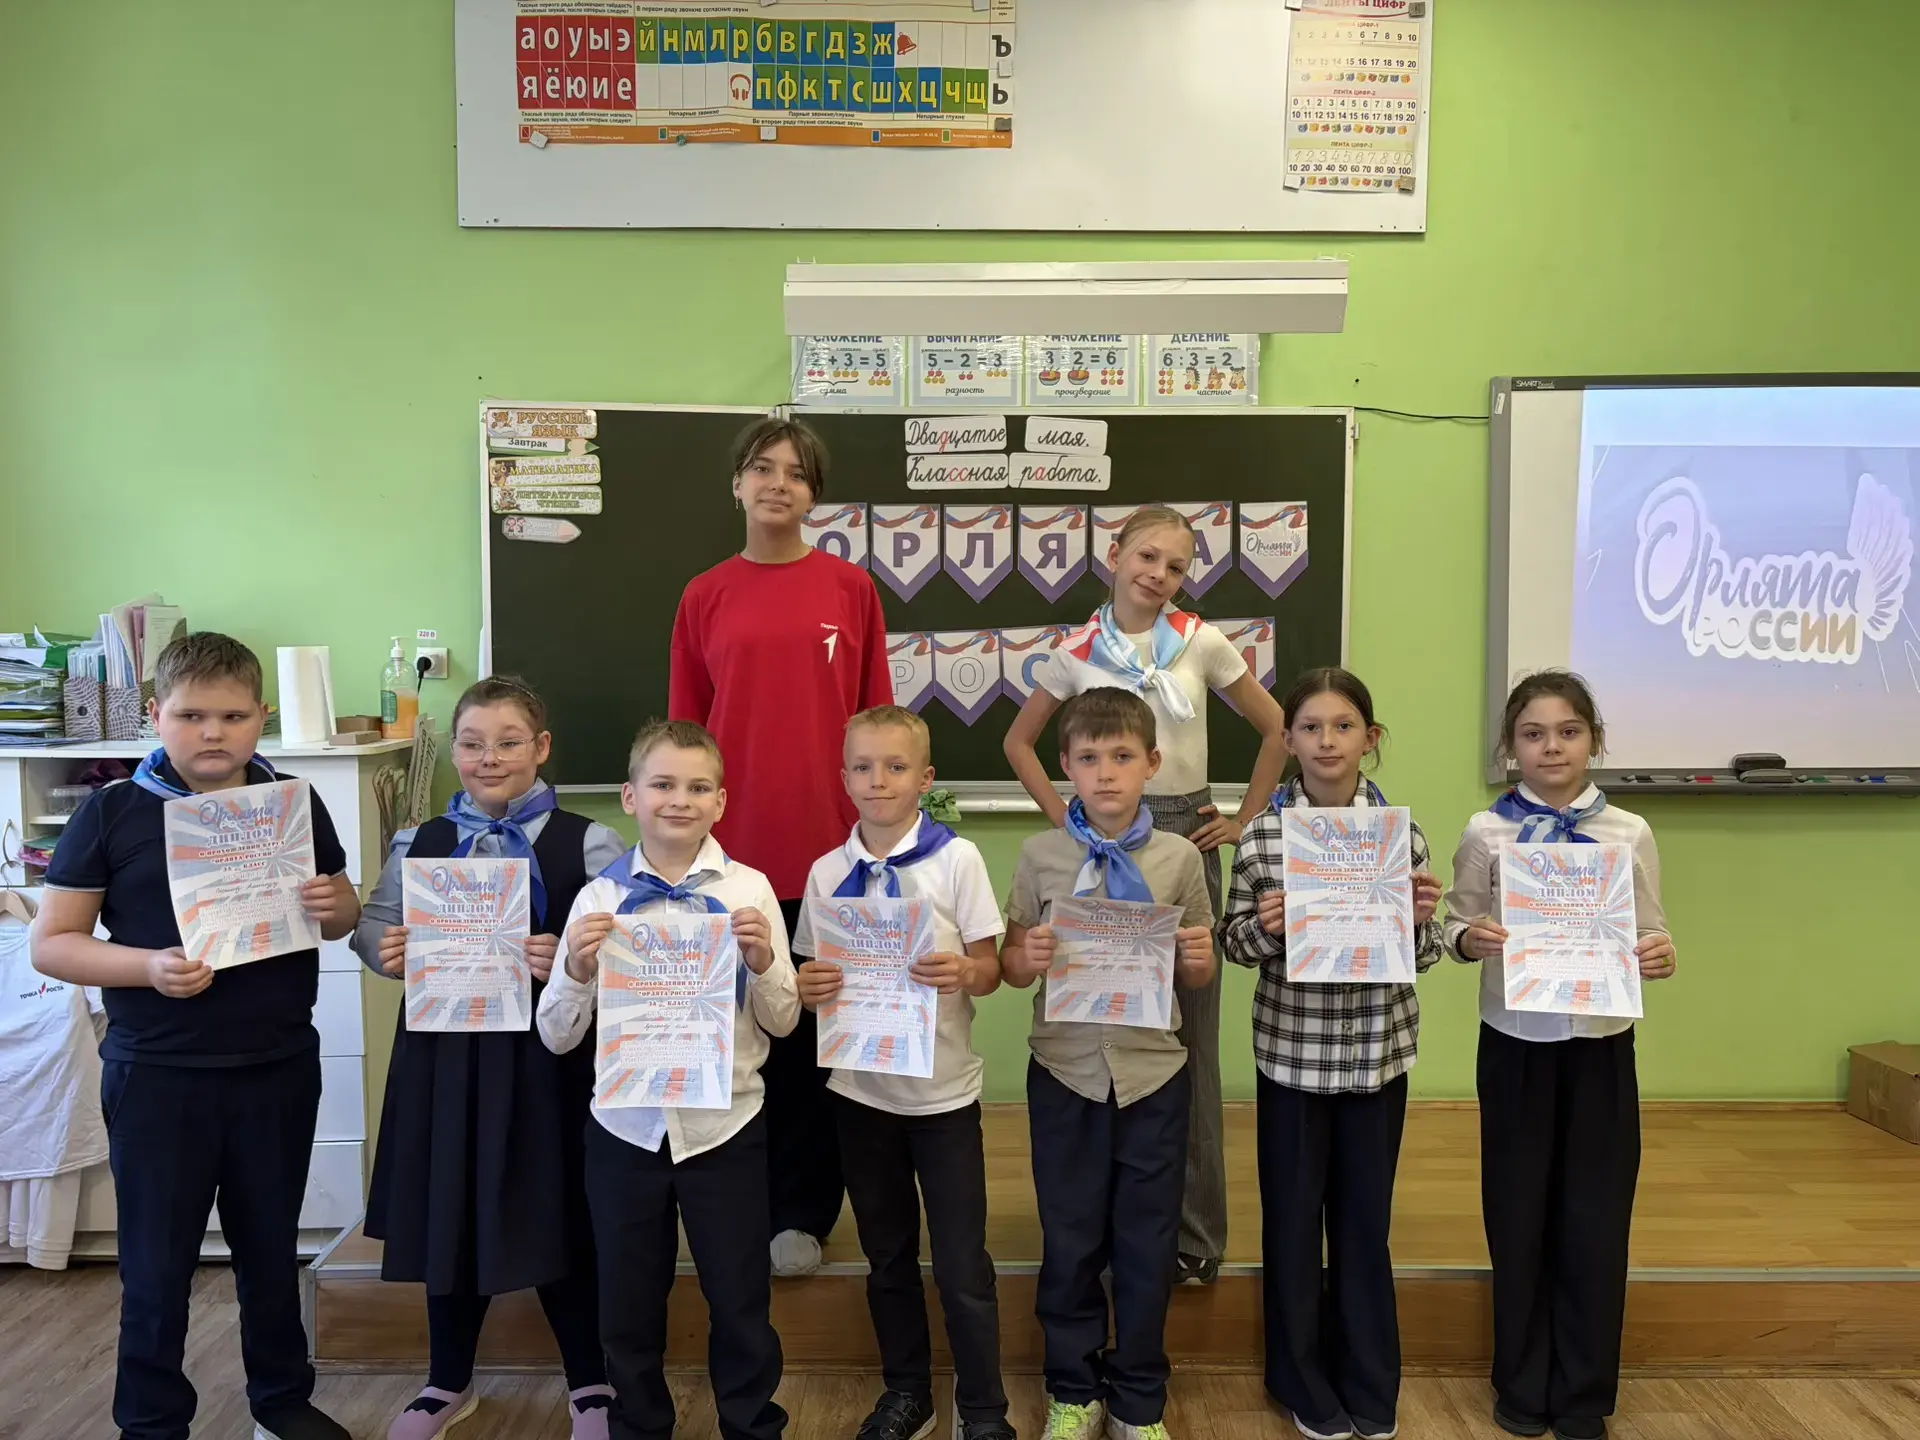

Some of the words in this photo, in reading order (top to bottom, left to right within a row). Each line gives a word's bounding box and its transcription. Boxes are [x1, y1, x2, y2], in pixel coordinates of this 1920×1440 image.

[521, 27, 536, 50] а
[544, 27, 560, 50] о
[568, 26, 583, 58] у
[589, 28, 610, 51] ы
[617, 28, 631, 51] э
[640, 20, 655, 51] й
[664, 29, 679, 52] н
[685, 30, 705, 52] м
[710, 29, 726, 50] л
[733, 29, 748, 58] р
[757, 22, 773, 52] б
[780, 32, 796, 53] в
[806, 32, 817, 53] г
[827, 32, 844, 59] д
[852, 32, 866, 55] з
[873, 33, 892, 55] ж
[523, 76, 538, 98] я
[546, 67, 560, 98] ё
[566, 76, 587, 98] ю
[593, 77, 608, 99] и
[617, 78, 632, 100] е
[756, 78, 771, 99] п
[777, 70, 797, 108] ф
[803, 79, 817, 100] к
[828, 79, 842, 101] т
[852, 80, 864, 103] с
[872, 81, 892, 103] ш
[899, 81, 912, 103] х
[921, 81, 937, 108] ц
[945, 81, 960, 103] ч
[966, 82, 986, 109] щ
[1338, 164, 1348, 172] 50
[1362, 165, 1371, 173] 70
[1386, 166, 1396, 174] 90
[1171, 333, 1231, 344] ДЕЛЕНИЕ
[844, 353, 853, 367] 3
[876, 353, 886, 367] 5
[928, 353, 937, 367] 5
[960, 353, 970, 367] 2
[1045, 351, 1054, 365] 3
[1074, 351, 1083, 365] 2
[1106, 351, 1116, 365] 6
[1164, 353, 1173, 367] 6
[1189, 353, 1199, 366] 3
[1222, 353, 1232, 366] 2
[945, 386, 984, 397] разность
[1055, 387, 1111, 397] произведение
[517, 410, 592, 425] РУССКИЙ
[531, 425, 579, 437] ЯЗЫК
[906, 420, 1005, 454] Двадцатое
[1038, 430, 1090, 447] мая.
[508, 437, 548, 448] Завтрак
[907, 456, 1008, 482] Классная
[1018, 456, 1102, 488] работа.
[1641, 486, 1861, 631] Орлята
[207, 827, 273, 847] ДИПЛОМ
[1317, 851, 1375, 863] ДИПЛОМ
[1537, 887, 1596, 899] ДИПЛОМ
[438, 902, 495, 915] ДИПЛОМ
[847, 938, 902, 950] ДИПЛОМ
[636, 963, 699, 976] ДИПЛОМ
[20, 991, 38, 999] ТОЧКА
[46, 985, 64, 993] РОСТА
